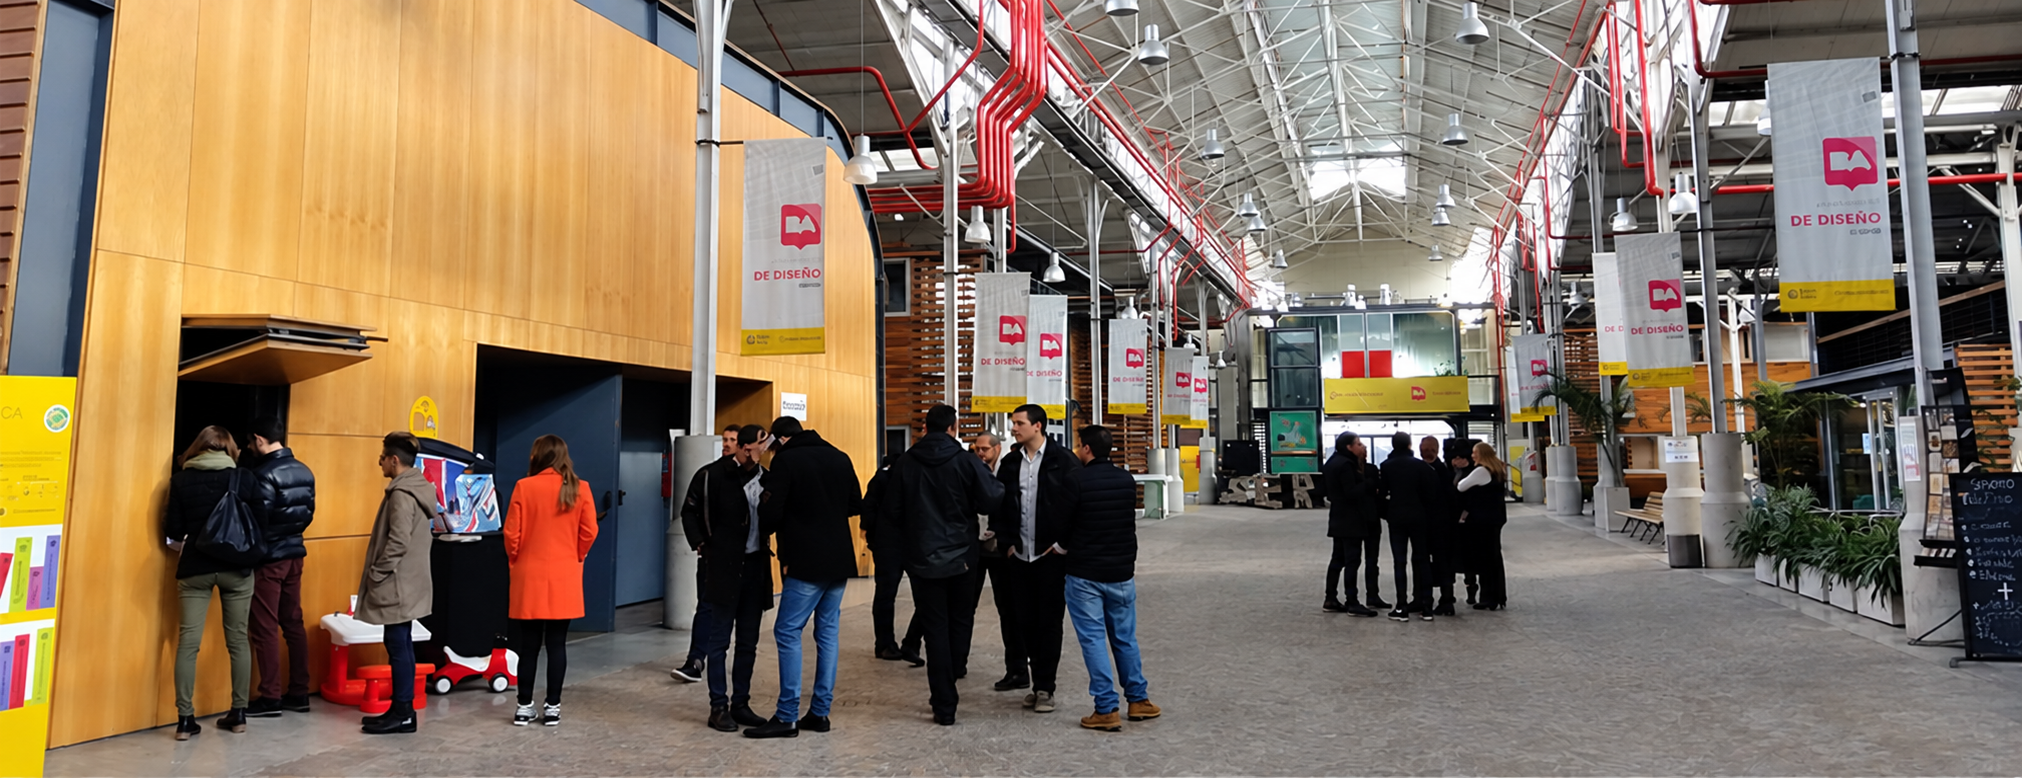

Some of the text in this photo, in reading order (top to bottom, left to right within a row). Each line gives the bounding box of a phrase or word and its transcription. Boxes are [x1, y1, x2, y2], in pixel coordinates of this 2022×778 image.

[1790, 210, 1882, 227] DE DISEÑO
[753, 266, 822, 281] DE DISEÑO
[1604, 325, 1615, 333] DE
[1630, 326, 1644, 335] DE
[1647, 323, 1684, 334] DISEÑO
[981, 355, 1026, 366] DE DISEÑO
[1036, 368, 1063, 377] DISEÑO
